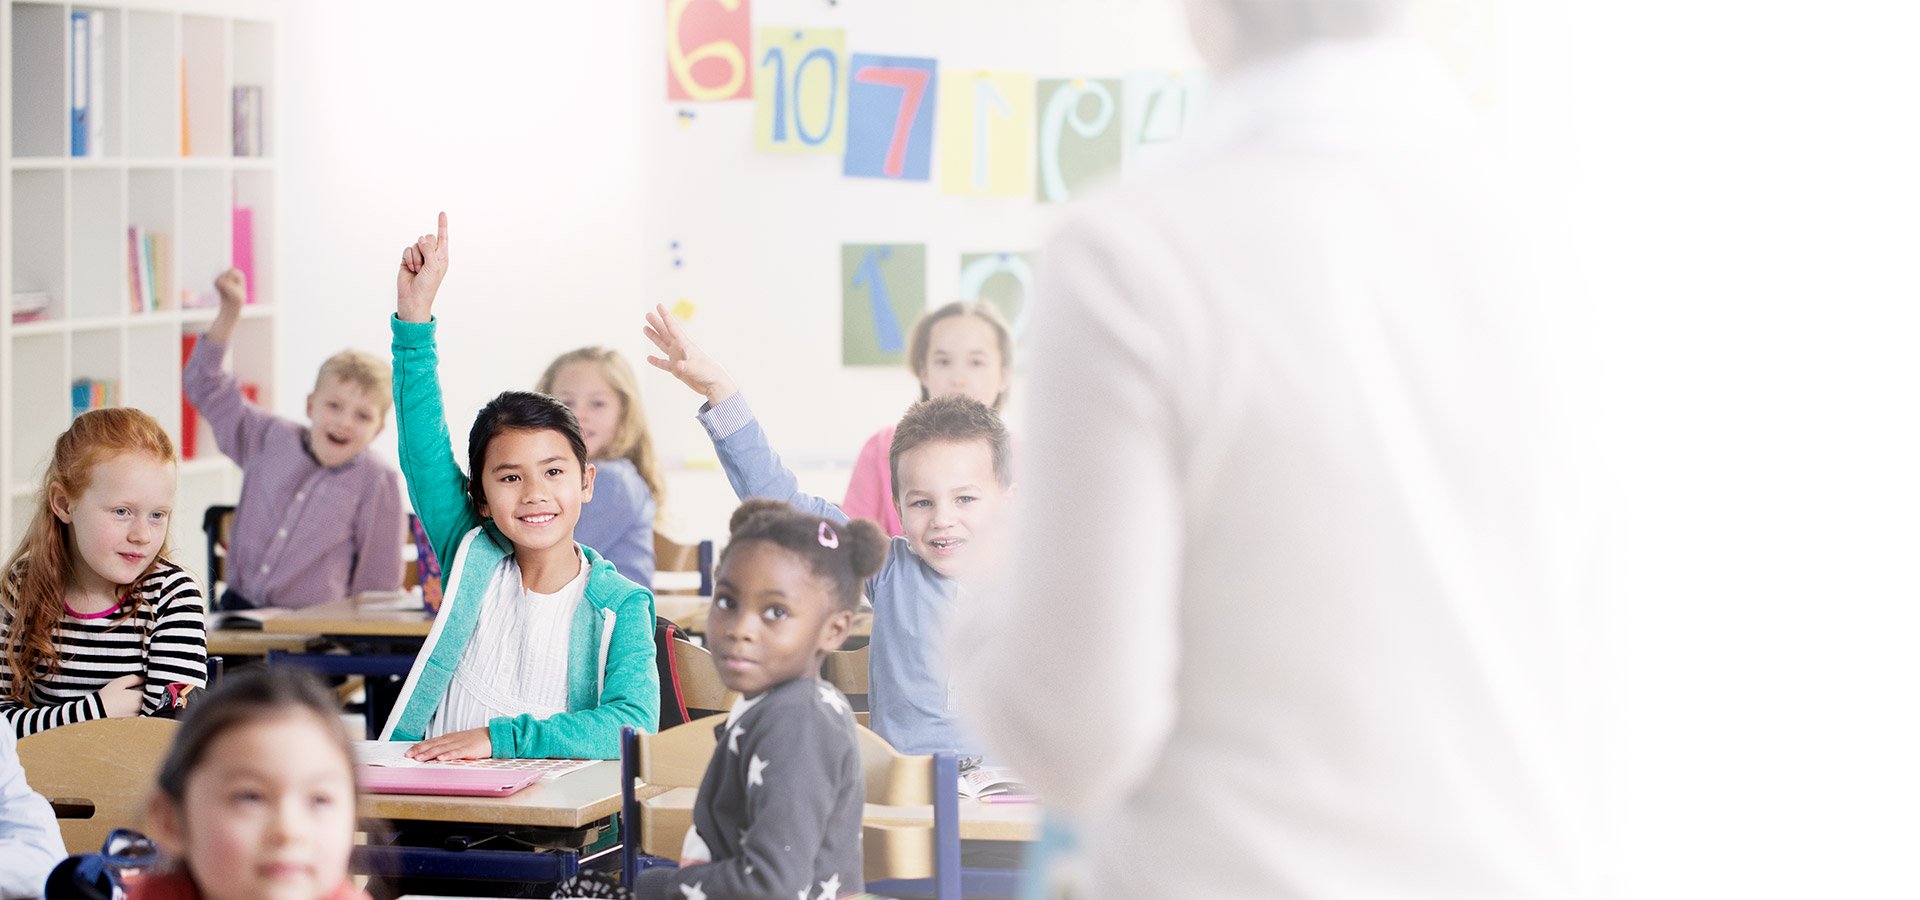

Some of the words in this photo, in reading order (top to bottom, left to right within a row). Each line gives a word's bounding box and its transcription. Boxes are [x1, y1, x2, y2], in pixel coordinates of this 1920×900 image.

[667, 0, 745, 100] 6
[761, 46, 839, 146] 10
[855, 67, 930, 177] 7
[853, 247, 905, 353] 1
